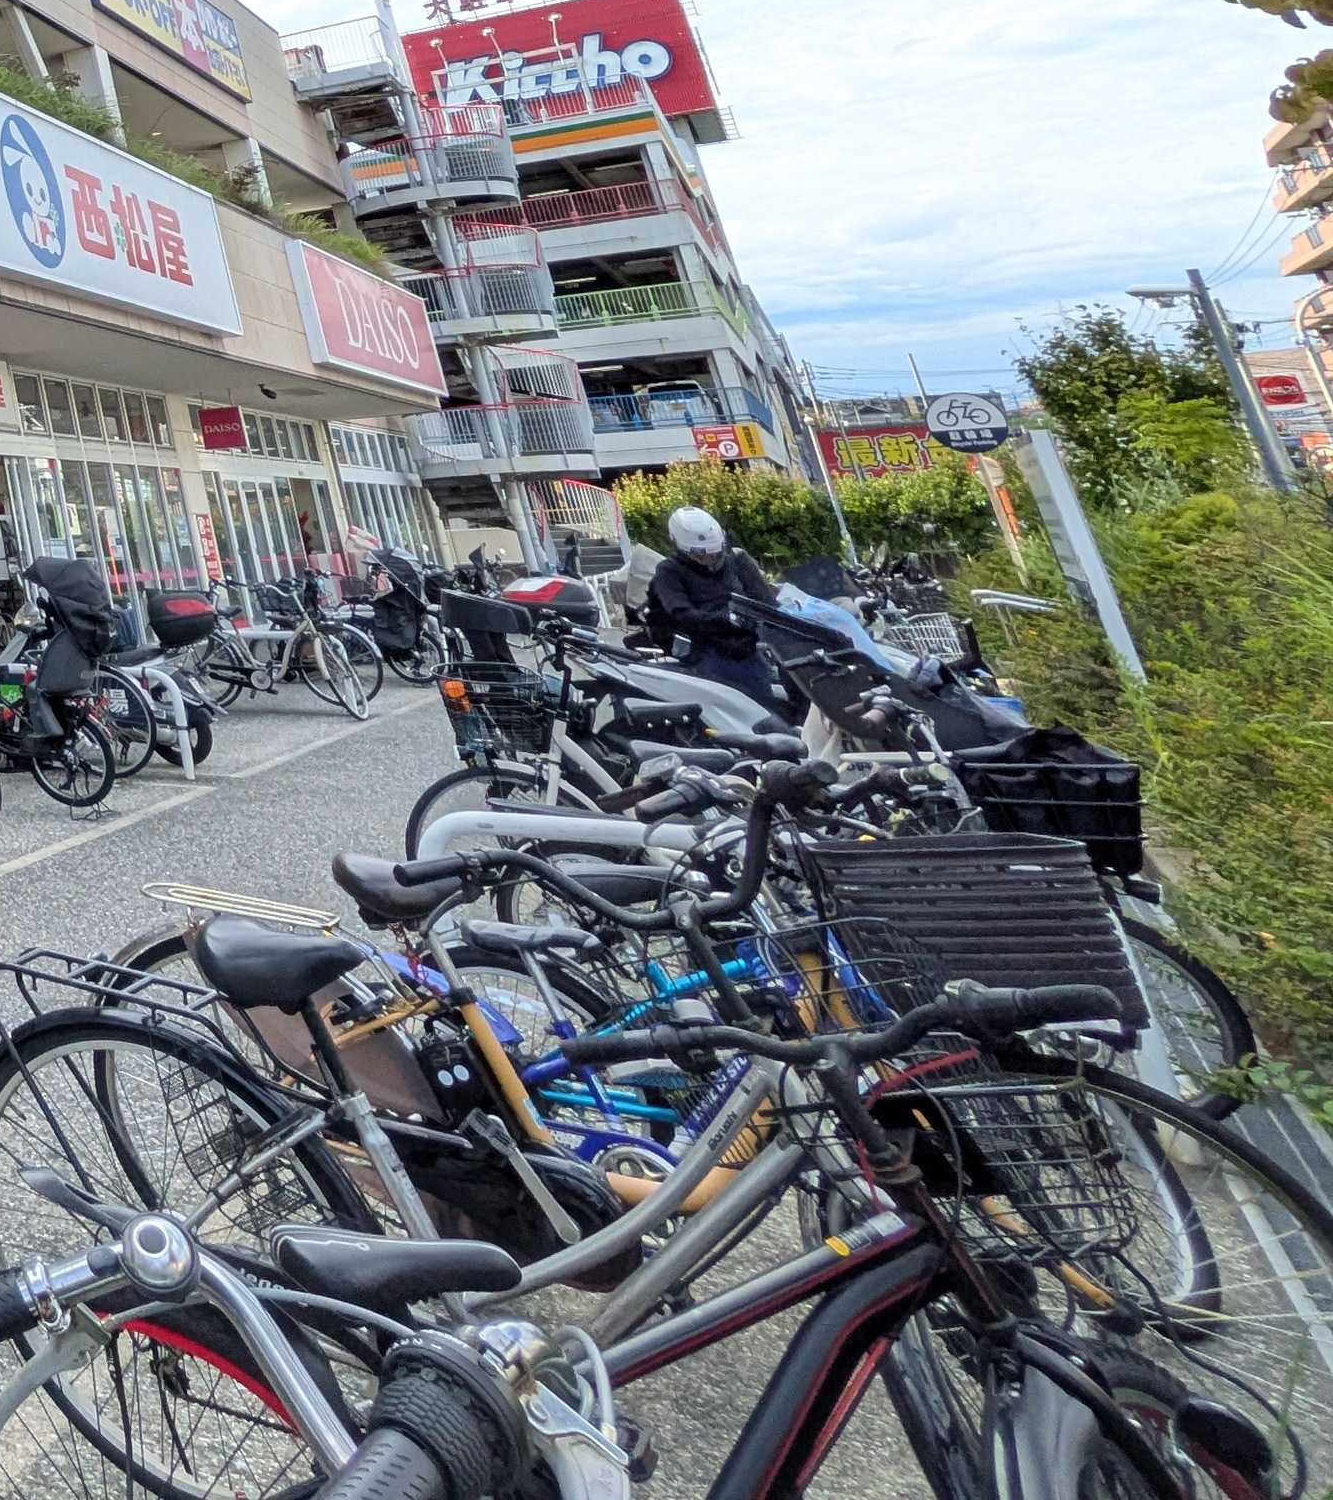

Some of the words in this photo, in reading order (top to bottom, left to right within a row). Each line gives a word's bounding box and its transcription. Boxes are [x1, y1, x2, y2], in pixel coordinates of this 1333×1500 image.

[64, 164, 193, 287] 西松屋
[335, 277, 420, 370] DAISO
[204, 421, 242, 436] DAISO
